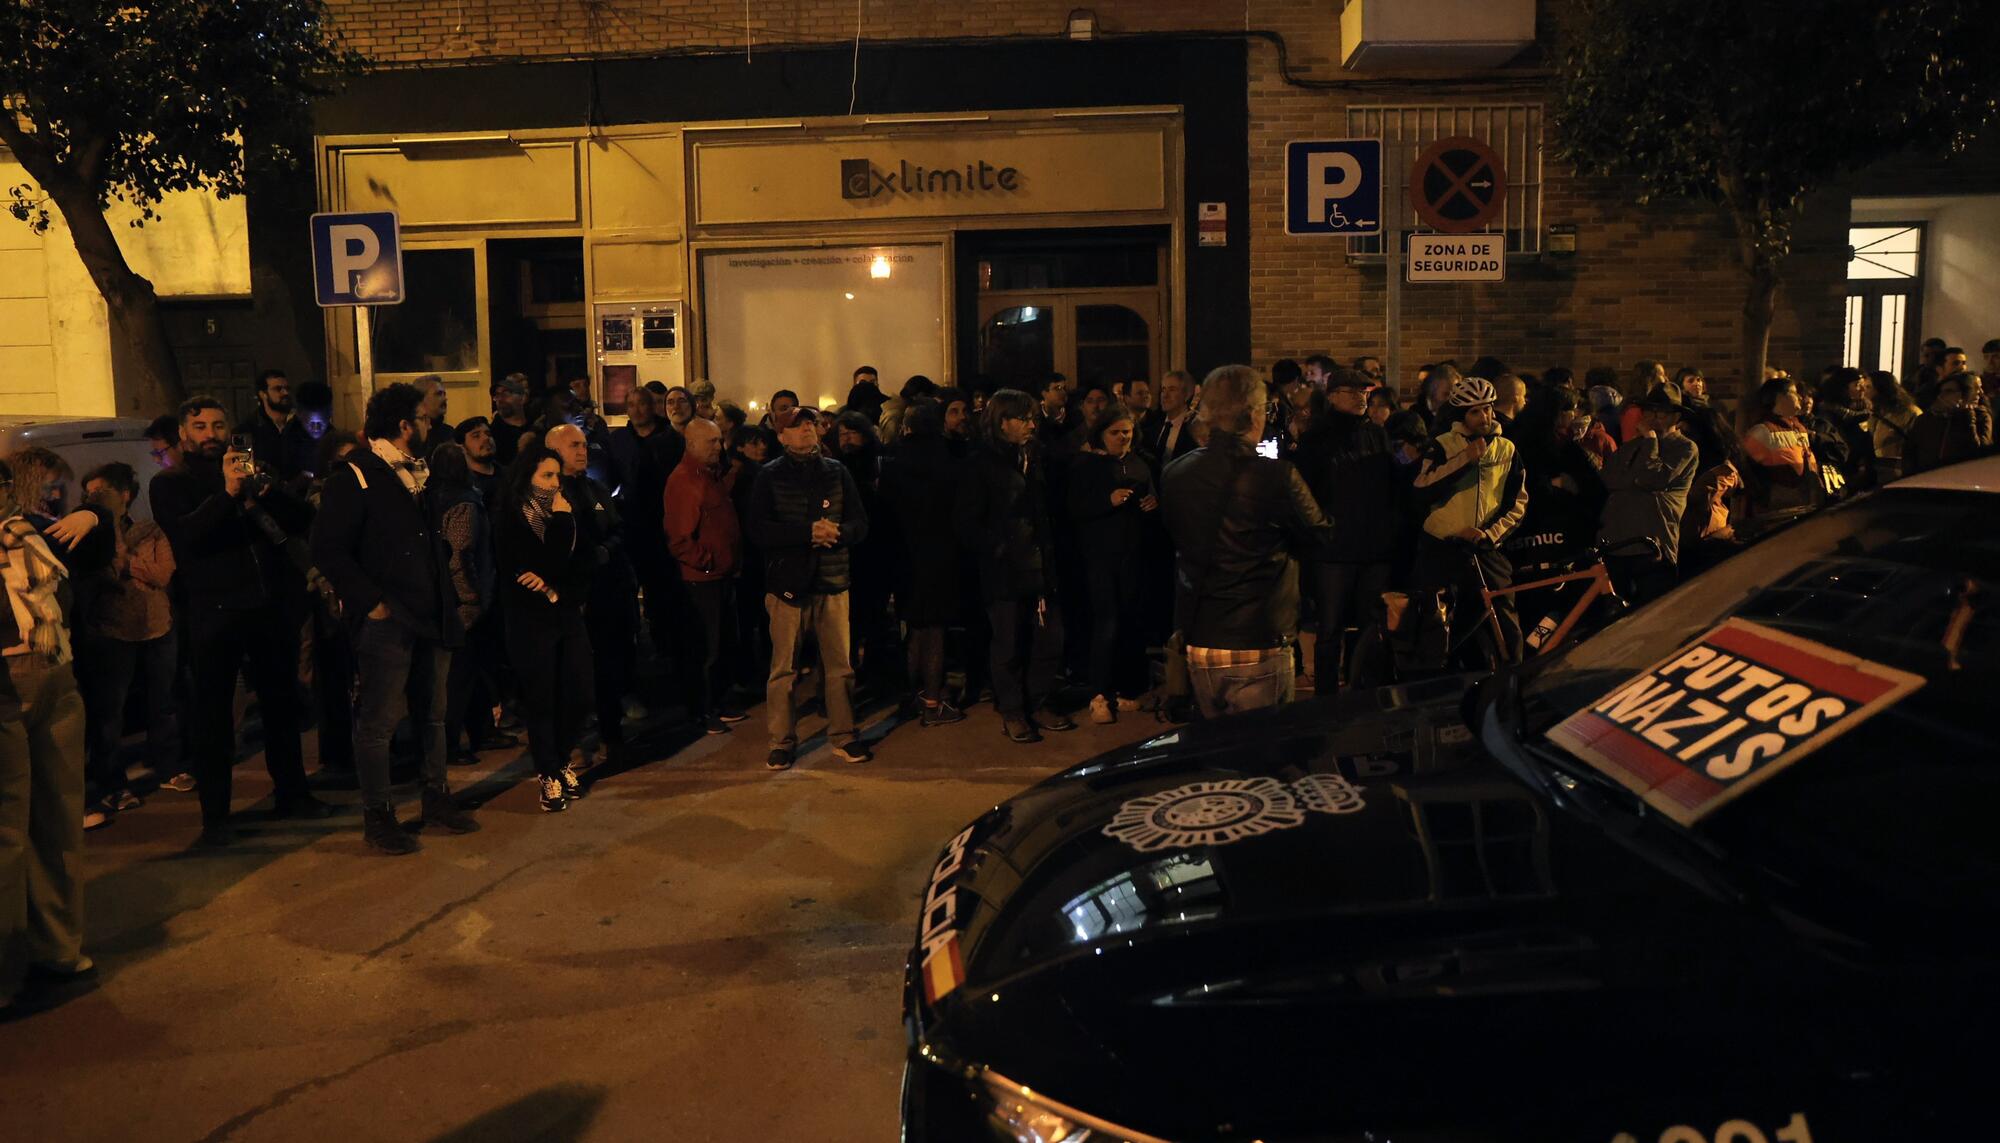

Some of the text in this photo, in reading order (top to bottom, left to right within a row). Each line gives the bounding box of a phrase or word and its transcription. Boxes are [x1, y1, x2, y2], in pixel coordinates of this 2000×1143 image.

[841, 159, 1018, 199] exlimite
[1307, 151, 1362, 223] P
[329, 223, 380, 294] P
[1414, 260, 1500, 272] SEGURIDAD
[1424, 244, 1490, 256] ZONA DE
[207, 319, 216, 335] 5
[1658, 645, 1846, 736] PUTOS
[1594, 674, 1786, 779] NAZIS
